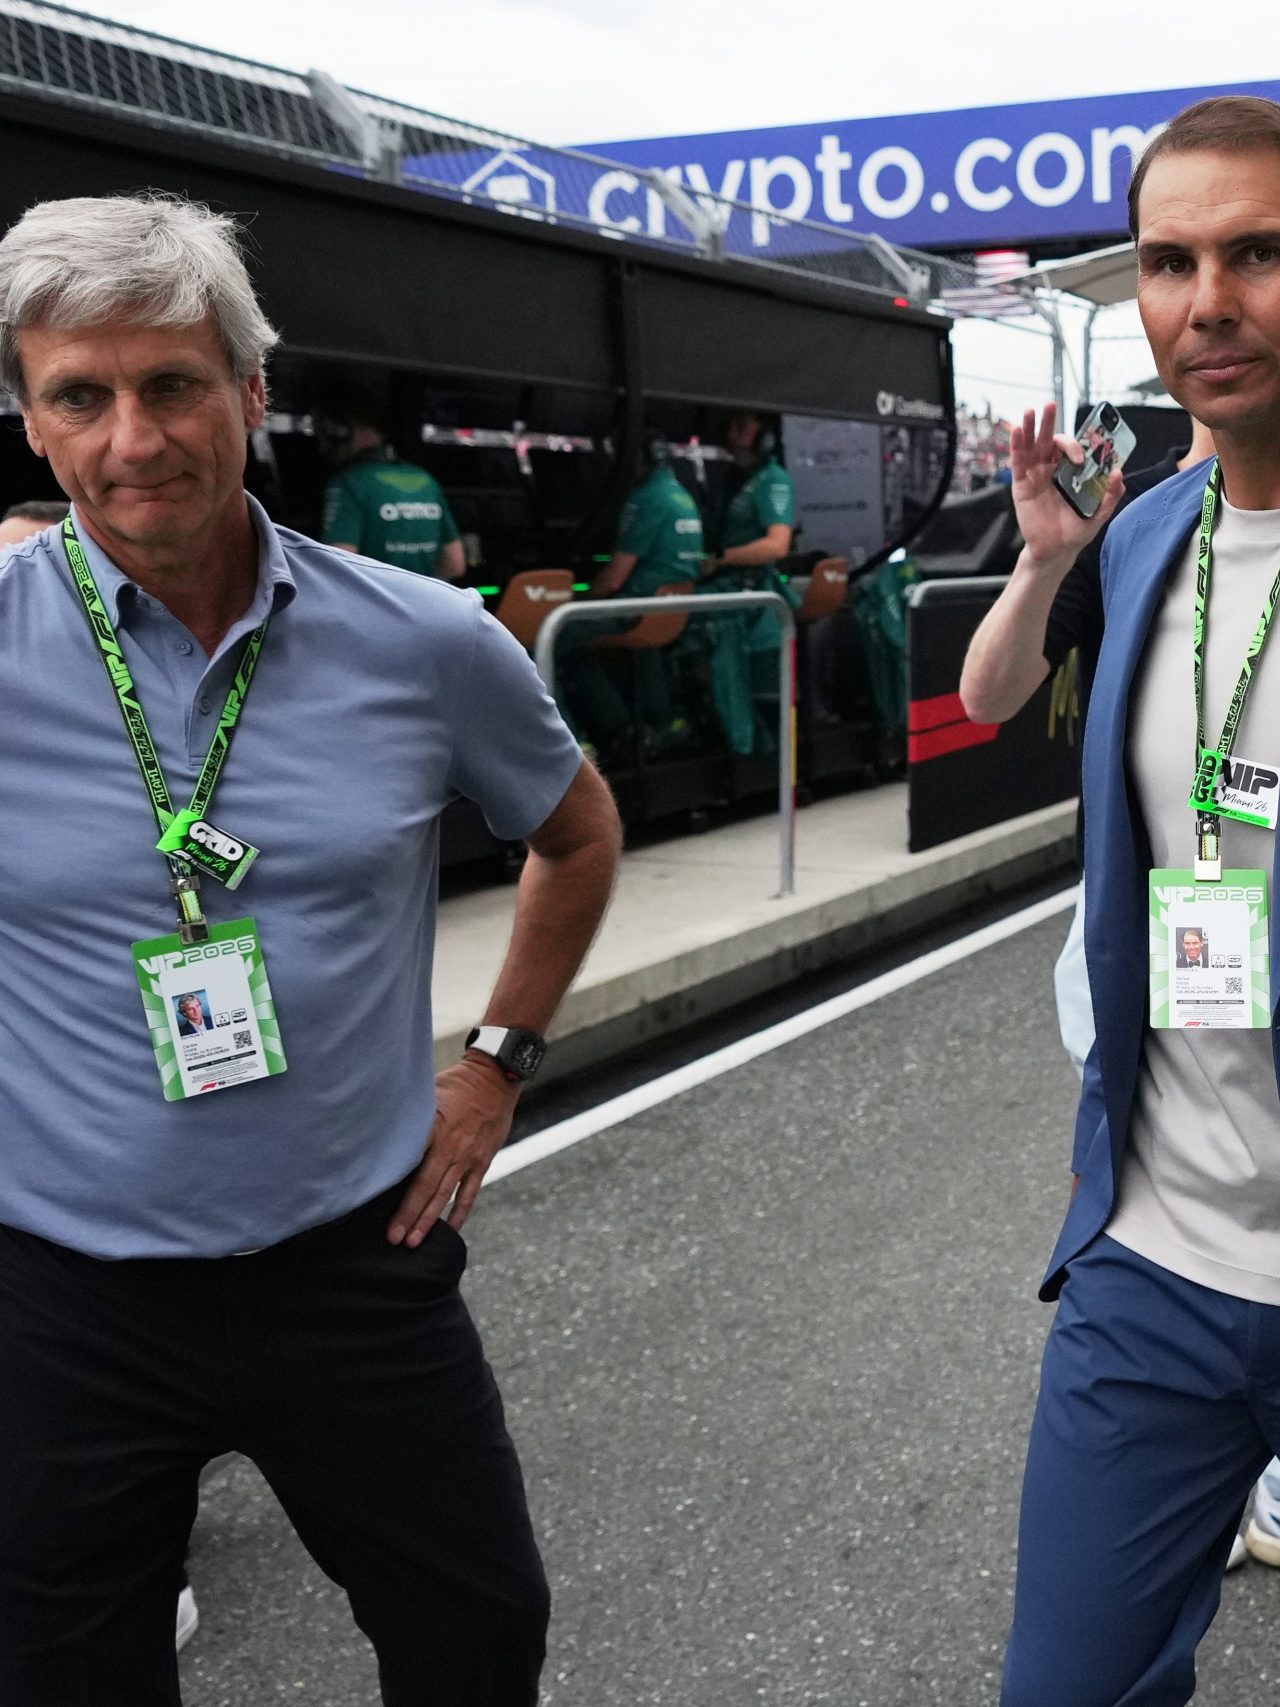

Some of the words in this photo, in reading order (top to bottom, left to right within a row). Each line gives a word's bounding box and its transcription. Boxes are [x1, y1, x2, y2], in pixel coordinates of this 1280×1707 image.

[1200, 493, 1214, 535] 2026
[68, 545, 90, 583] 2026
[82, 582, 97, 606] VIP
[106, 653, 134, 695] VIP
[222, 689, 243, 729] VIP
[147, 767, 167, 803] MIAMI
[1194, 755, 1217, 803] GRID
[1221, 757, 1280, 795] VIP
[189, 820, 244, 862] GRID
[1153, 886, 1195, 903] VIP
[1196, 887, 1263, 903] 2026
[138, 950, 184, 975] VIP
[183, 935, 257, 963] 2026
